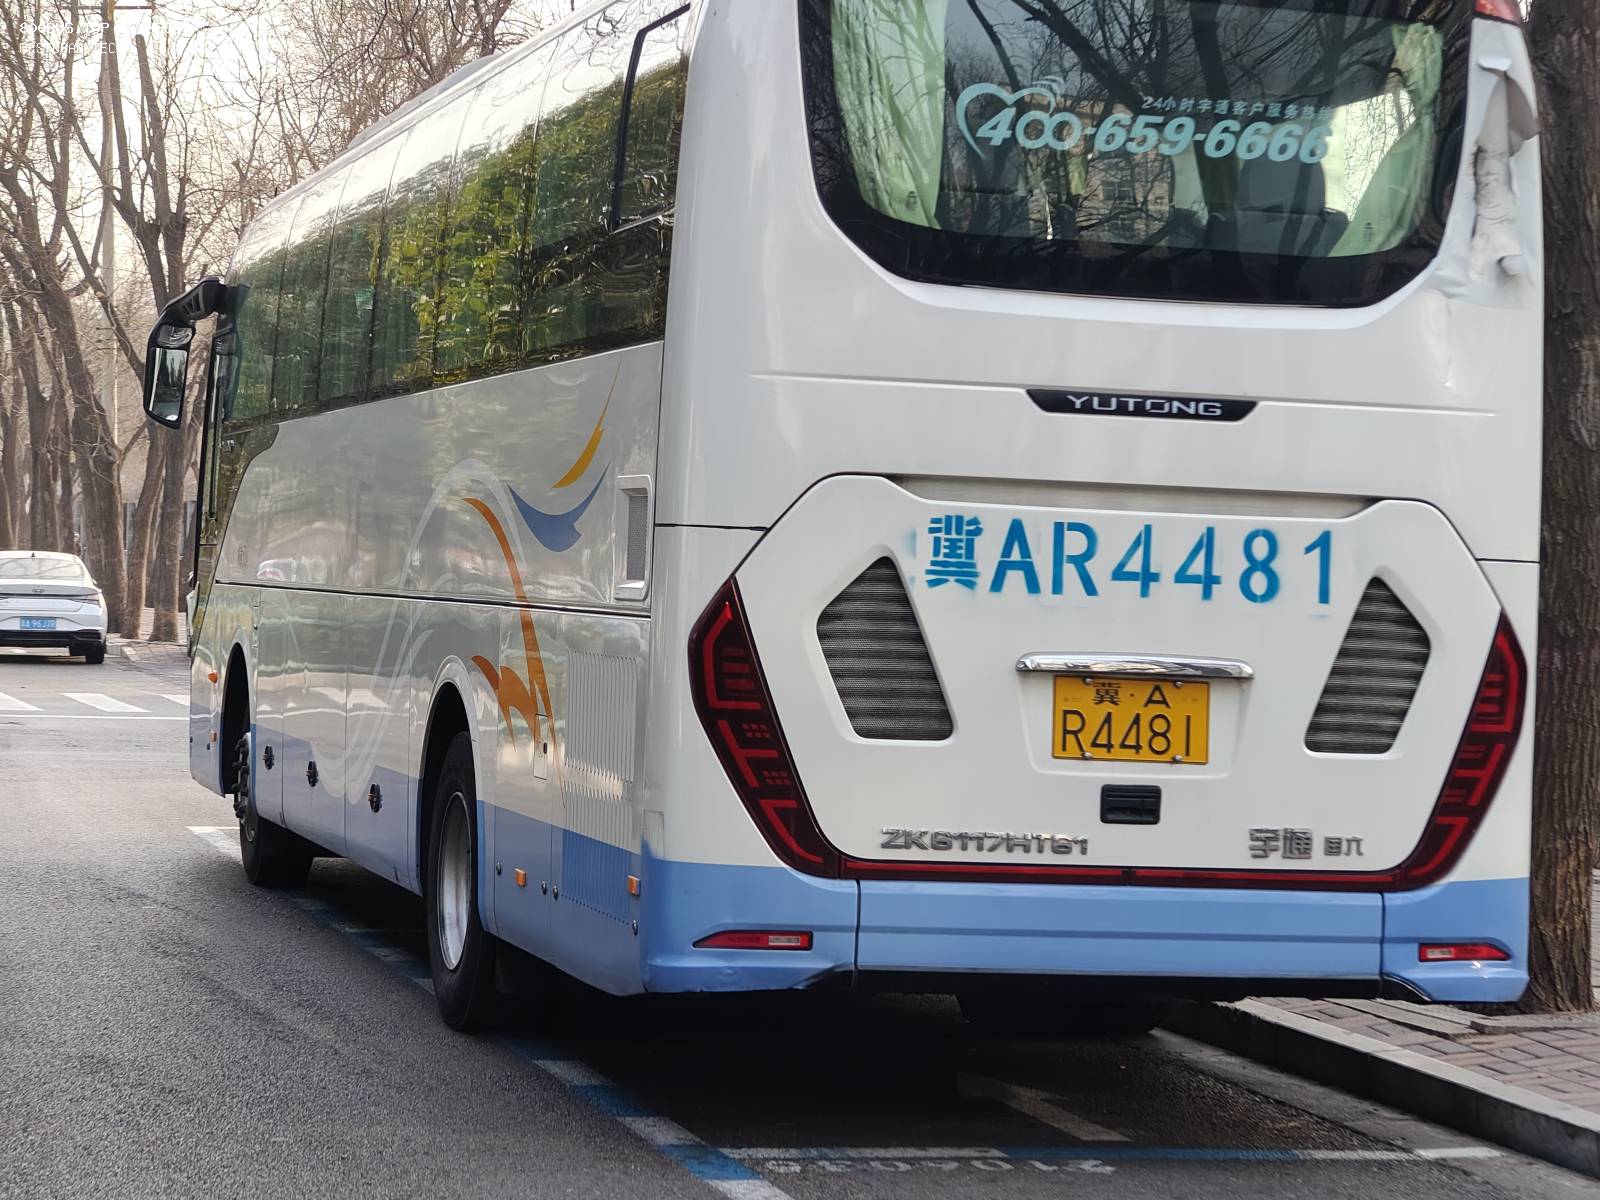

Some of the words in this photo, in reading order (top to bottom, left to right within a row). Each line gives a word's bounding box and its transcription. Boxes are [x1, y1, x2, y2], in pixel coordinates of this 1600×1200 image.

[975, 106, 1334, 165] 400-659-6666
[1066, 394, 1223, 417] YUTONG
[924, 514, 1333, 605] 冀AR4481
[1061, 709, 1191, 757] R4481
[1248, 827, 1313, 860] 宇通
